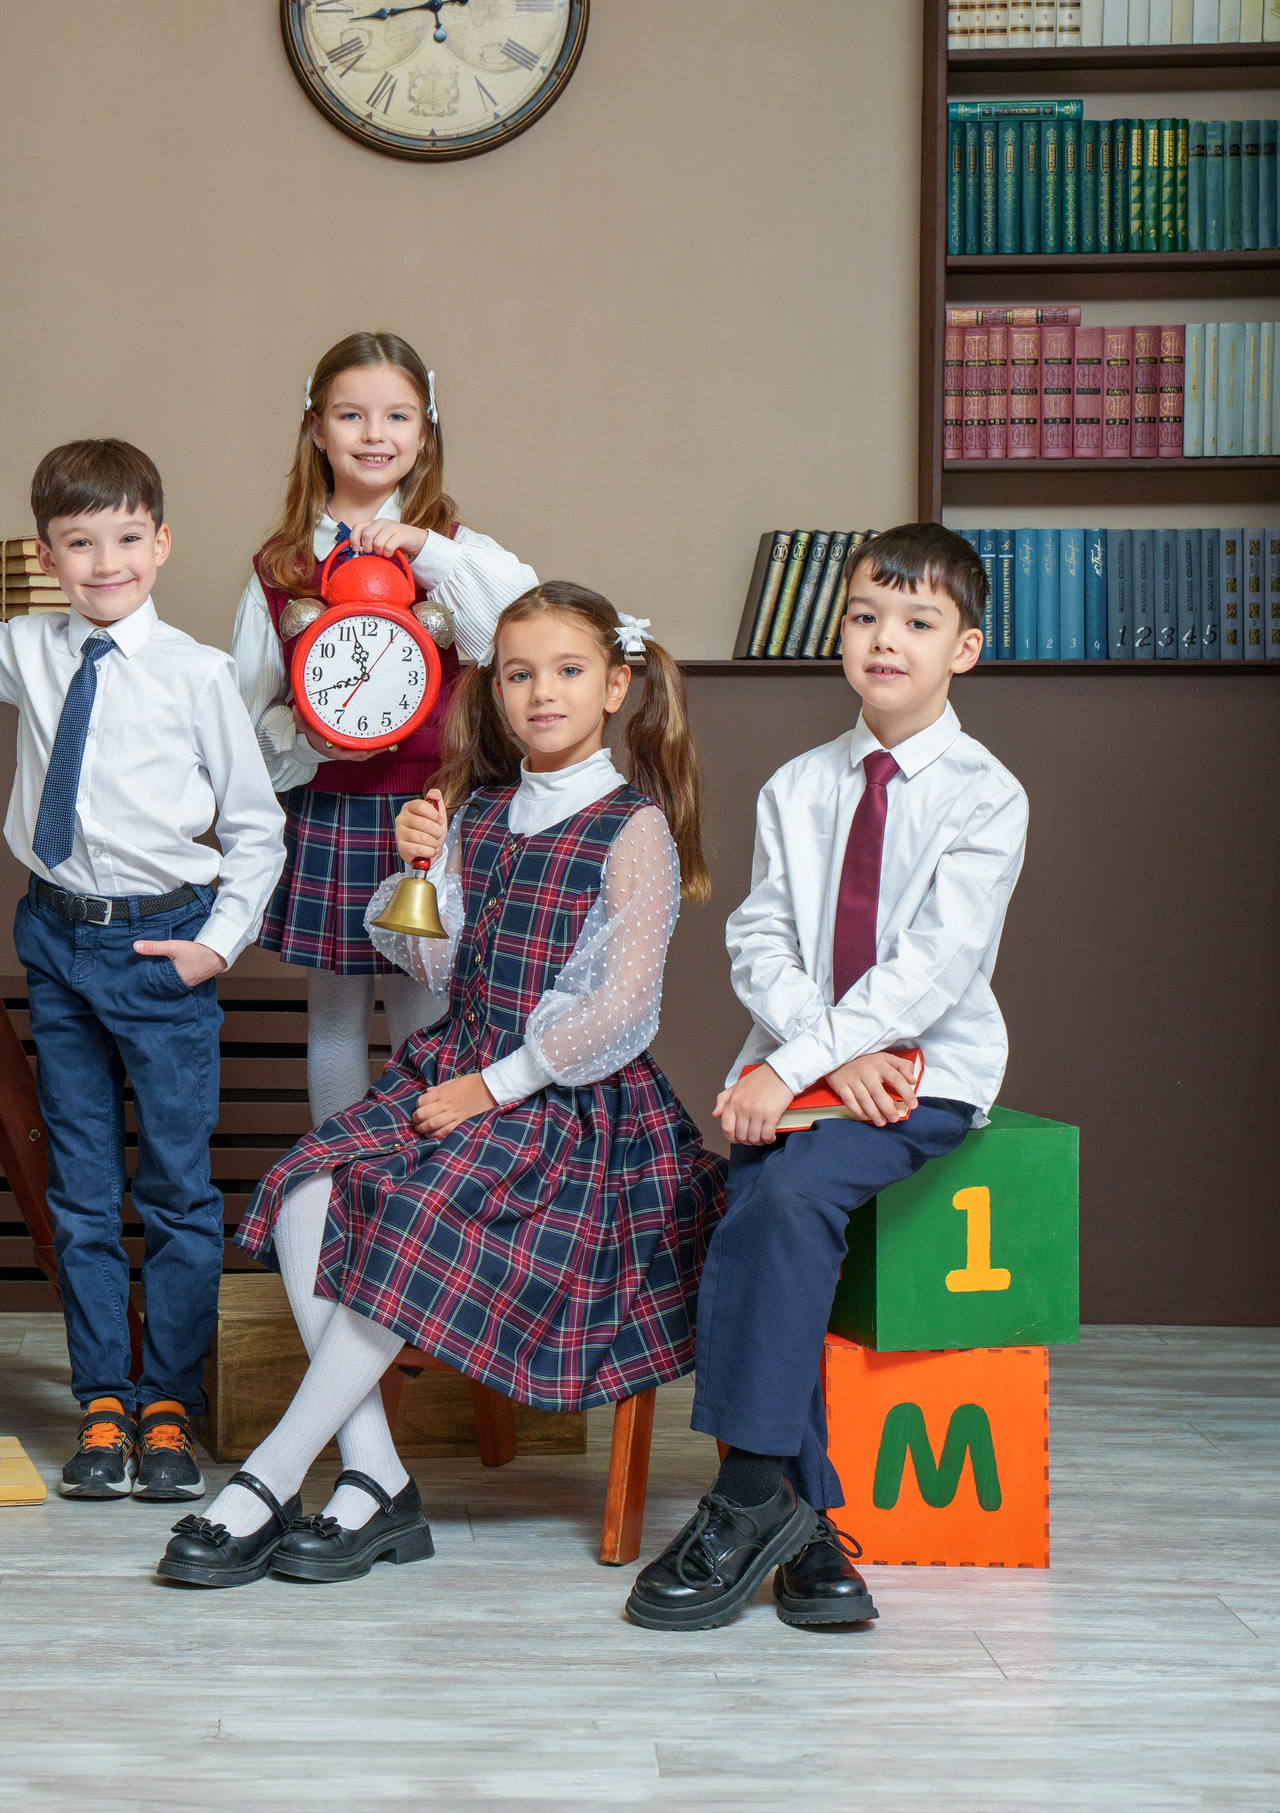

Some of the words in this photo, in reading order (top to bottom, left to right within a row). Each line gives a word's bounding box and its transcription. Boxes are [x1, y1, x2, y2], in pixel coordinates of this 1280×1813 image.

[1150, 229, 1156, 237] 2
[1168, 230, 1173, 238] 3
[984, 540, 993, 551] 3
[338, 626, 352, 642] 11
[360, 621, 378, 636] 12
[389, 628, 395, 643] 1
[985, 613, 993, 648] РИЧАРД
[1116, 625, 1126, 647] 1
[1182, 625, 1197, 647] 4
[1203, 624, 1218, 645] 5
[1024, 638, 1029, 649] 1
[1046, 638, 1053, 649] 2
[1070, 638, 1077, 648] 3
[1094, 640, 1100, 650] 4
[1134, 627, 1152, 647] 2
[1158, 627, 1175, 647] 3
[319, 643, 336, 659] 10
[402, 646, 413, 662] 2
[312, 666, 323, 682] 9
[408, 671, 419, 686] 3
[318, 690, 328, 706] 8
[398, 694, 410, 709] 4
[334, 709, 345, 724] 7
[357, 716, 368, 731] 6
[381, 711, 392, 727] 5
[945, 1186, 1011, 1293] 1
[873, 1402, 1002, 1512] М
